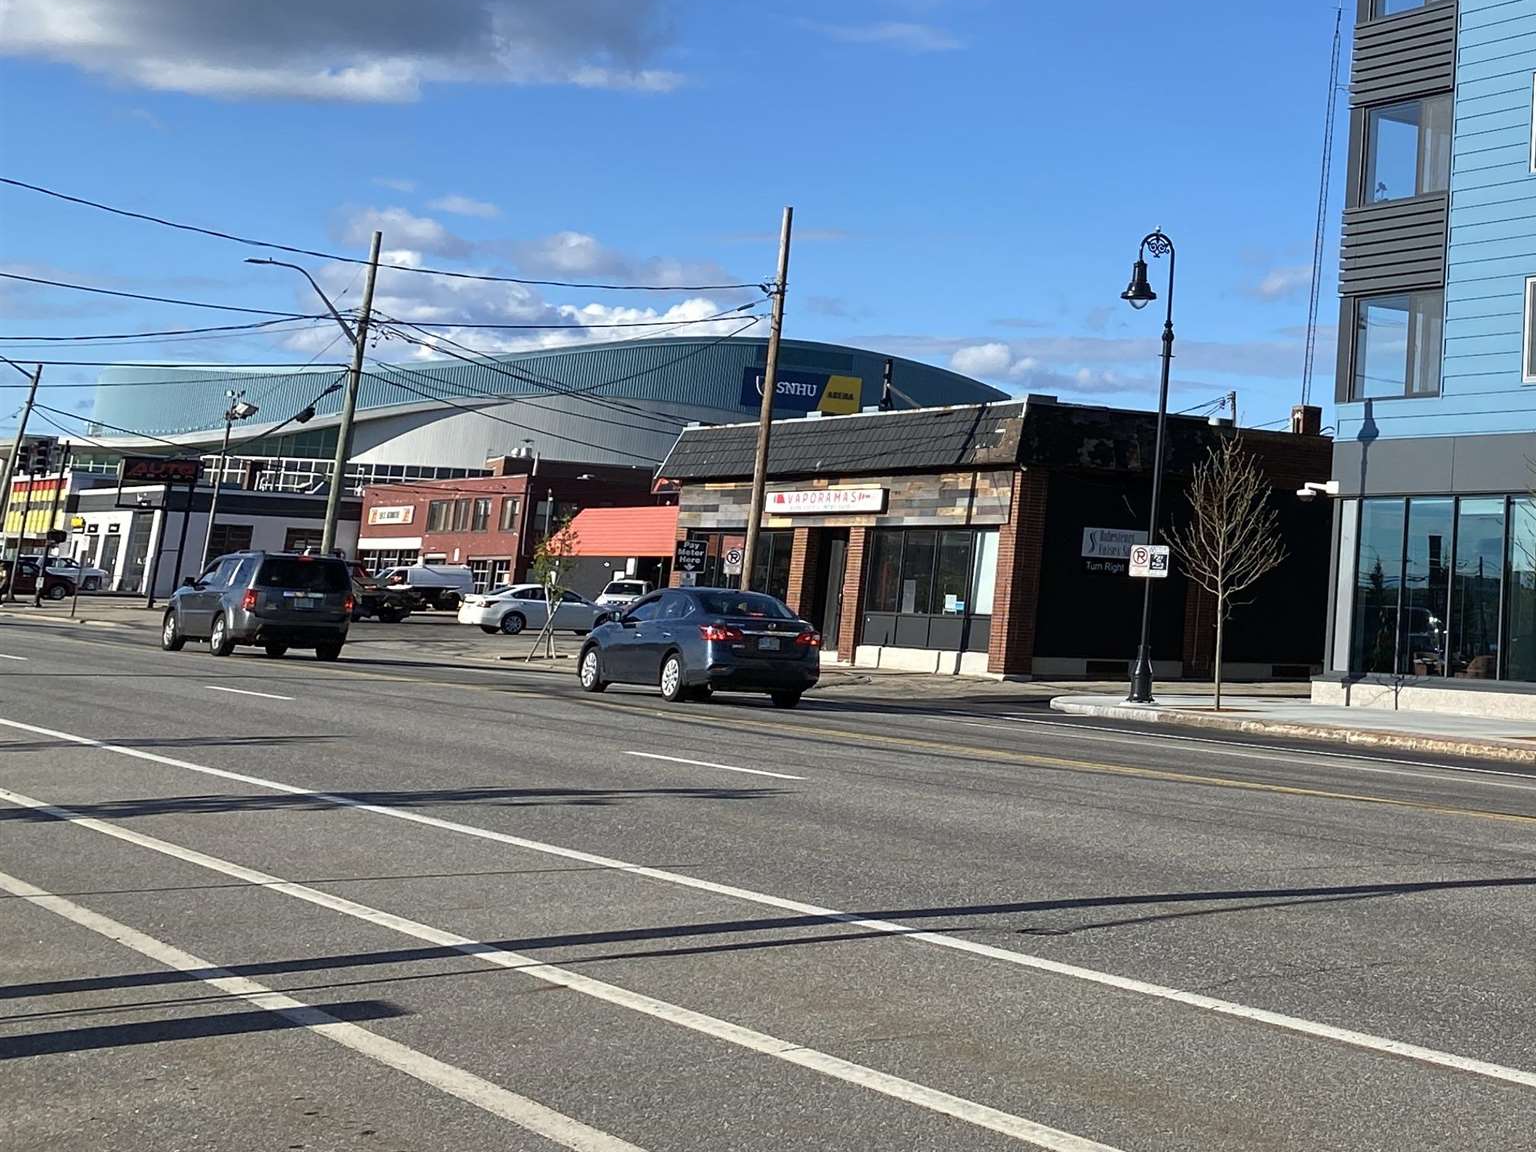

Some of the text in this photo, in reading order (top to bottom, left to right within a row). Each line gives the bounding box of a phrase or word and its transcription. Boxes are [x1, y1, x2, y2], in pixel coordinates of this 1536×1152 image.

[776, 381, 818, 397] SNHU
[684, 542, 701, 550] Pay
[679, 556, 701, 564] Here
[1086, 561, 1125, 573] Turn Right
